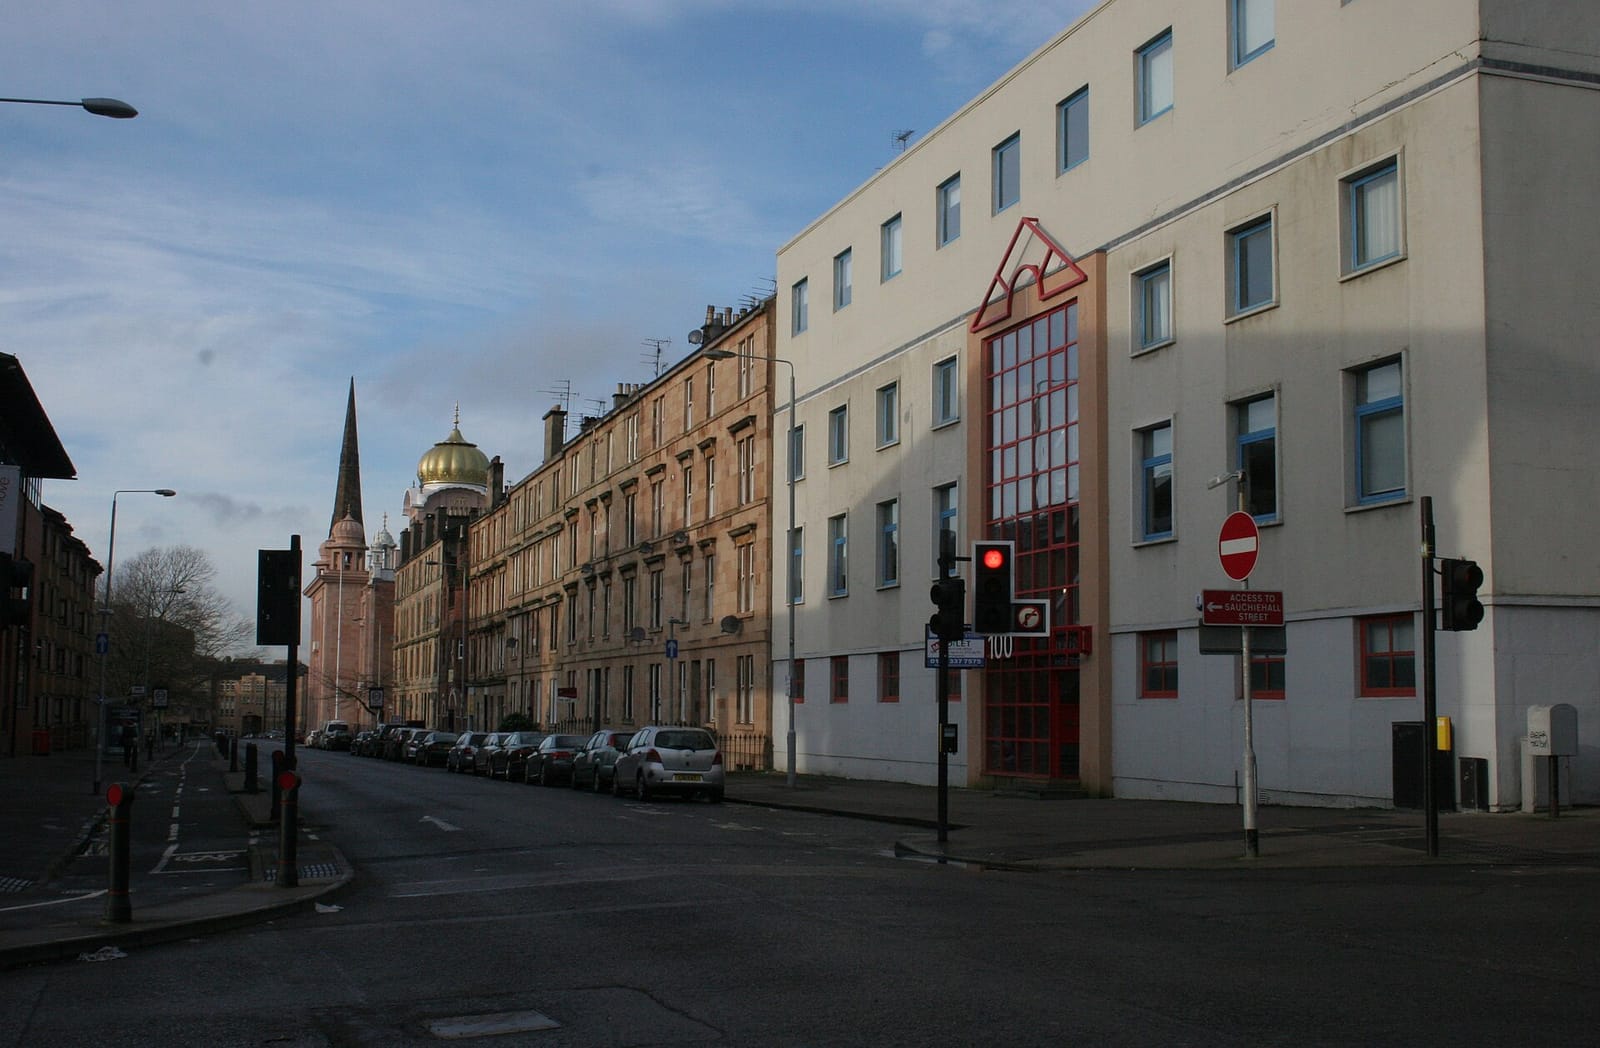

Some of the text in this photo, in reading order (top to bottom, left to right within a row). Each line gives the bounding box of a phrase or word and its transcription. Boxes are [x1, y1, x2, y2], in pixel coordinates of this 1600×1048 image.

[1230, 593, 1276, 603] ACCESS TO
[1224, 603, 1281, 612] SAUCHIEHALL
[1239, 612, 1269, 621] STREET
[987, 635, 1013, 660] 100
